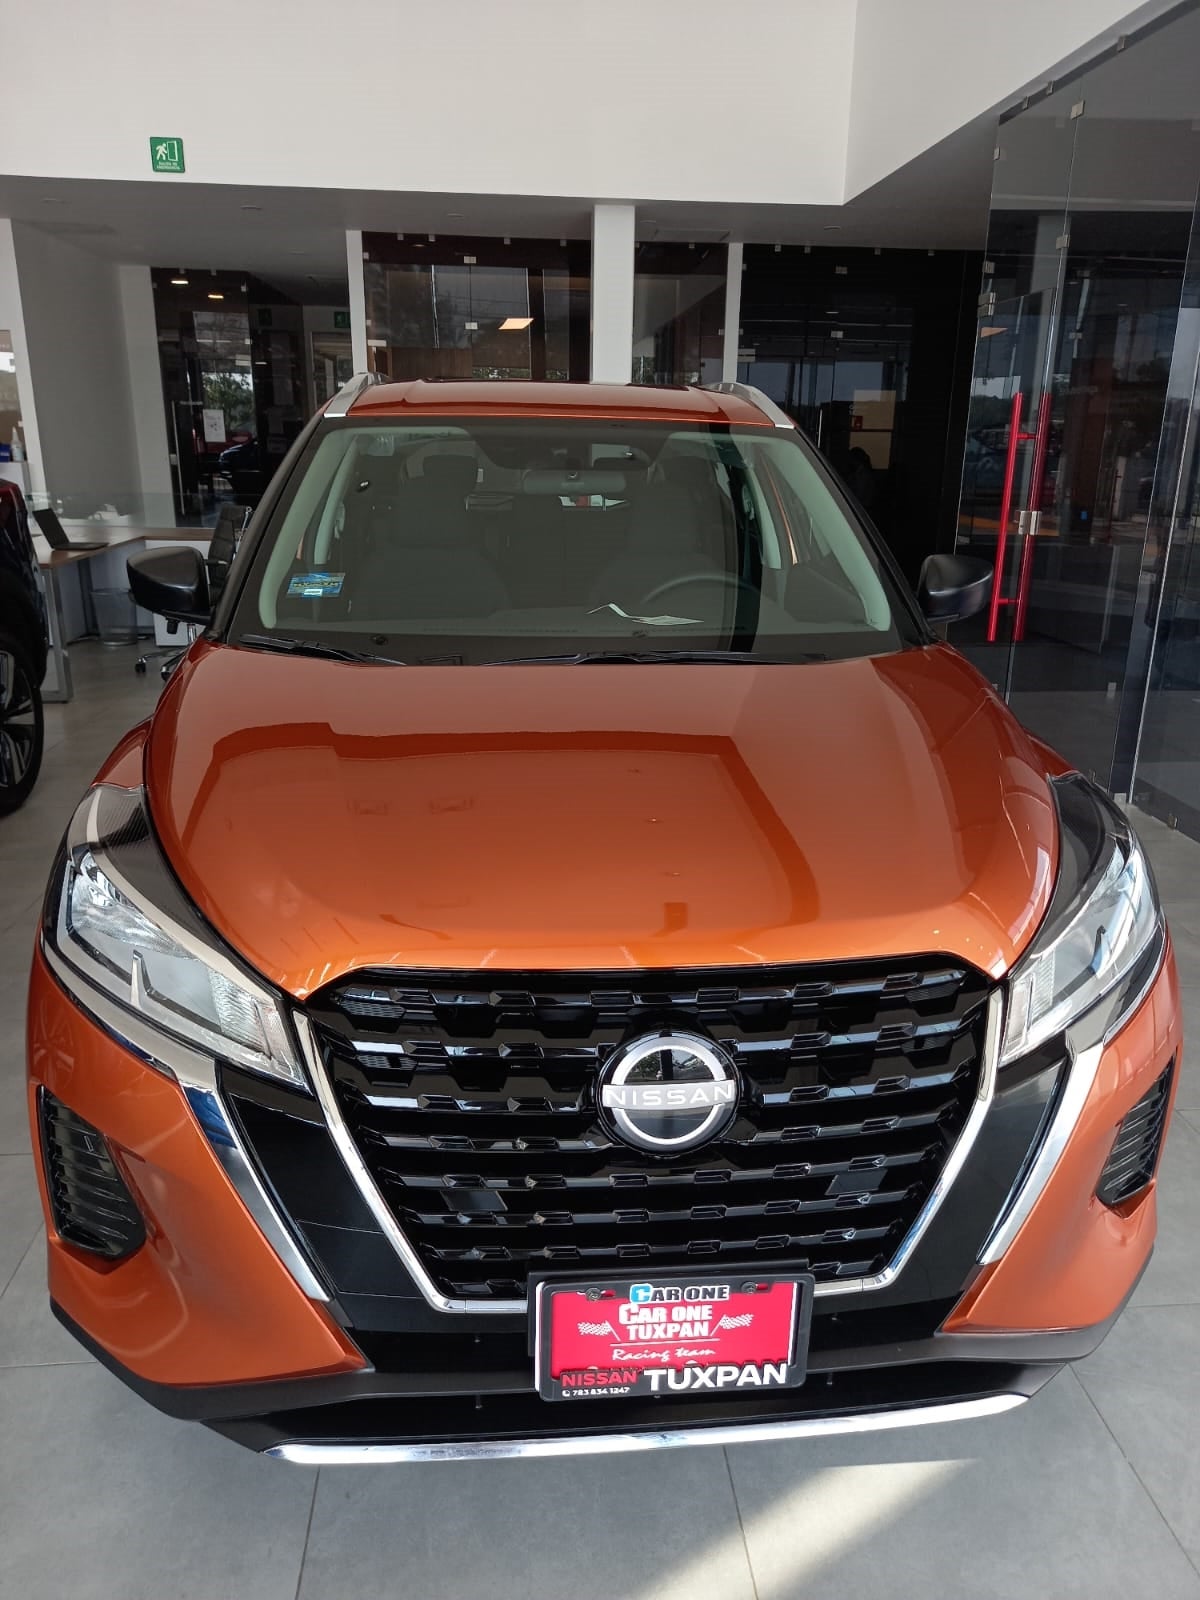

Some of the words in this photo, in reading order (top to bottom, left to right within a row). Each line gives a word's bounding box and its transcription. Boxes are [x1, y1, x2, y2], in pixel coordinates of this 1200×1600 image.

[606, 1083, 732, 1106] NISSAN
[630, 1283, 682, 1304] CAR
[682, 1284, 730, 1302] ONE
[619, 1303, 668, 1325] CAR
[671, 1304, 713, 1321] ONE
[626, 1322, 709, 1341] TUXPAN
[612, 1348, 670, 1362] Racing
[674, 1346, 716, 1358] team
[562, 1370, 638, 1387] NISSAN
[643, 1363, 789, 1392] TUXPAN
